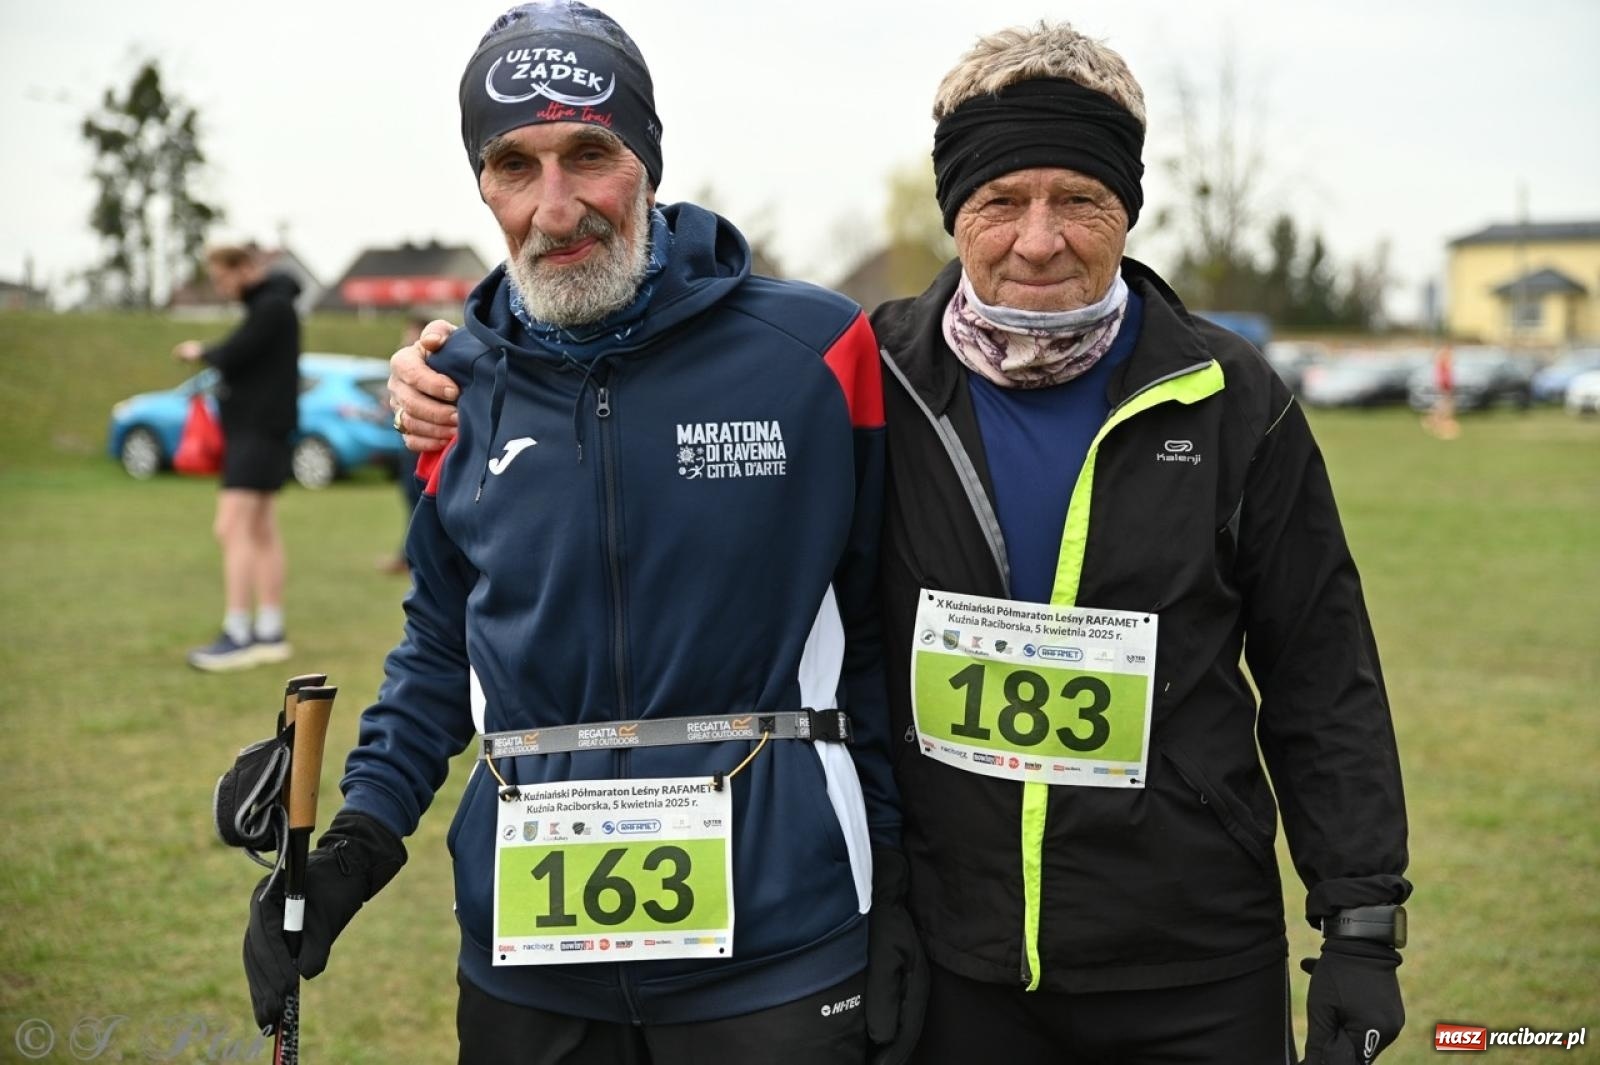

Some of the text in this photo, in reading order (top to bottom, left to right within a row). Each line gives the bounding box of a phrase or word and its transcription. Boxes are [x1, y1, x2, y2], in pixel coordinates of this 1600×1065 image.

[506, 48, 577, 64] ULTRA
[512, 63, 604, 91] ZADEK
[536, 102, 613, 128] ultra trail
[676, 421, 783, 445] MARATONA
[706, 441, 786, 462] DI RAVENNA
[707, 461, 786, 478] CITTÀ D'ARTE
[936, 599, 1139, 628] X Kuźniański Półmaraton Leśny RAFAMET
[948, 613, 1122, 641] Kuźnia Raciborska, 5 kwietnia 2025 r.
[948, 663, 1111, 752] 183
[578, 728, 617, 739] REGATTA
[687, 721, 730, 732] REGATTA
[688, 729, 753, 741] GREAT OUTDOORS
[495, 736, 523, 748] REGATTA
[578, 736, 639, 747] GREAT OUTDOORS
[524, 789, 569, 801] Kuźniański
[571, 787, 630, 798] Półmaraton
[632, 785, 659, 796] Leśny
[662, 784, 712, 795] RAFAMET
[527, 798, 698, 814] Kuźnia Raciborska, 5 kwietnia 2025 r.
[530, 845, 694, 928] 163
[831, 995, 861, 1015] HI-TEC
